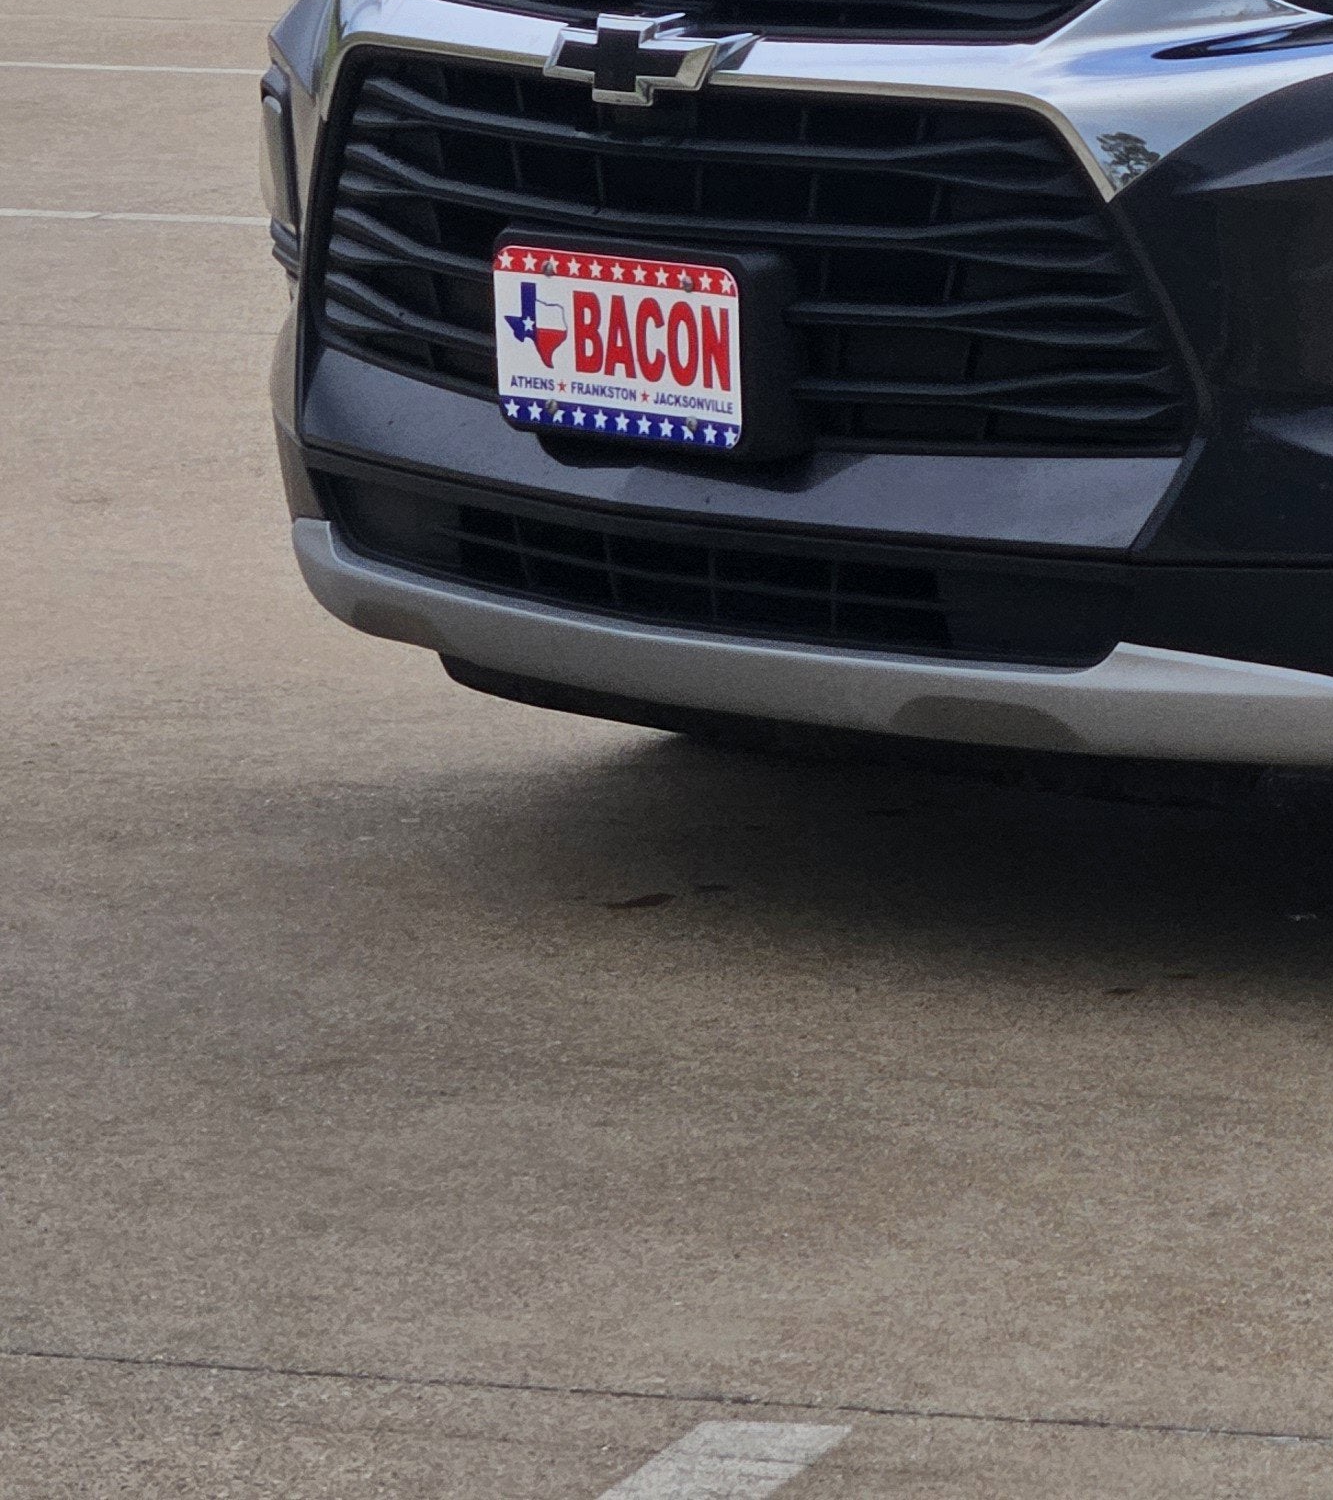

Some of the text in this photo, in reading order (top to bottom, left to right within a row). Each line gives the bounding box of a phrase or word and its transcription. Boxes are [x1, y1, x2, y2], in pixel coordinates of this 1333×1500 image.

[572, 290, 731, 392] BACON
[510, 374, 734, 415] ATHENS FRANKSTON JACKSONVILLE
